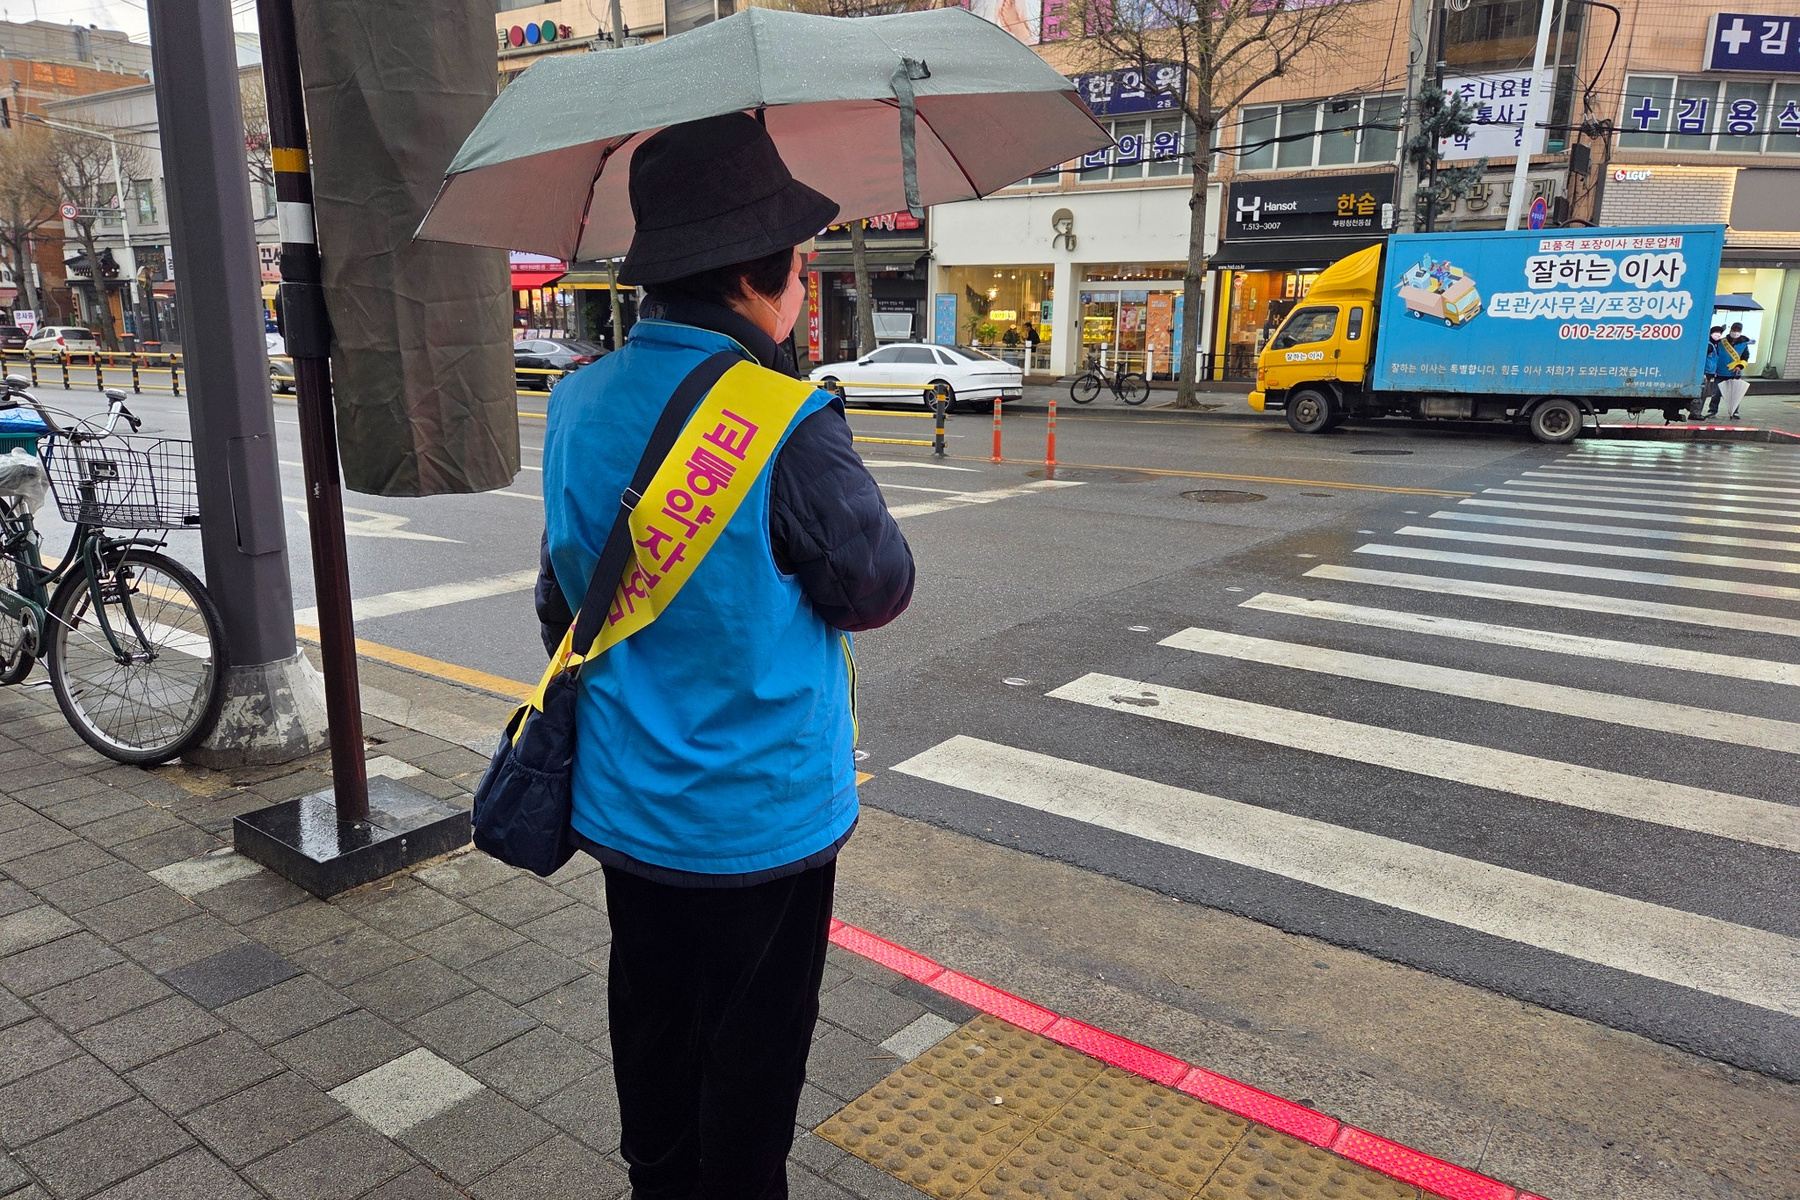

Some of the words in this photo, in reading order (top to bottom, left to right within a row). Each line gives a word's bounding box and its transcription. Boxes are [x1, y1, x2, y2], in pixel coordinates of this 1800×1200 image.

[1075, 66, 1181, 103] 한의원
[64, 206, 74, 216] 30
[1264, 200, 1297, 212] Hansot
[1337, 192, 1376, 217] 한솥
[1242, 222, 1281, 231] T.513-3007
[1541, 240, 1575, 251] 고품격
[1579, 238, 1628, 250] 포장이사
[1632, 236, 1682, 249] 전문업체
[1532, 259, 1611, 283] 잘하는
[1625, 257, 1680, 283] 이사
[1493, 295, 1686, 315] 보관/사무실/포장이사
[1560, 325, 1682, 340] 010-2275-2800
[1286, 353, 1306, 362] 잘하는
[1309, 353, 1323, 361] 이사
[1391, 363, 1417, 374] 잘하는
[1421, 363, 1446, 374] 이사는
[1450, 364, 1497, 375] 특별합니다.
[1524, 365, 1542, 376] 이사
[1546, 365, 1575, 376] 저희가
[1578, 366, 1661, 378] 도와드리겠습니다.
